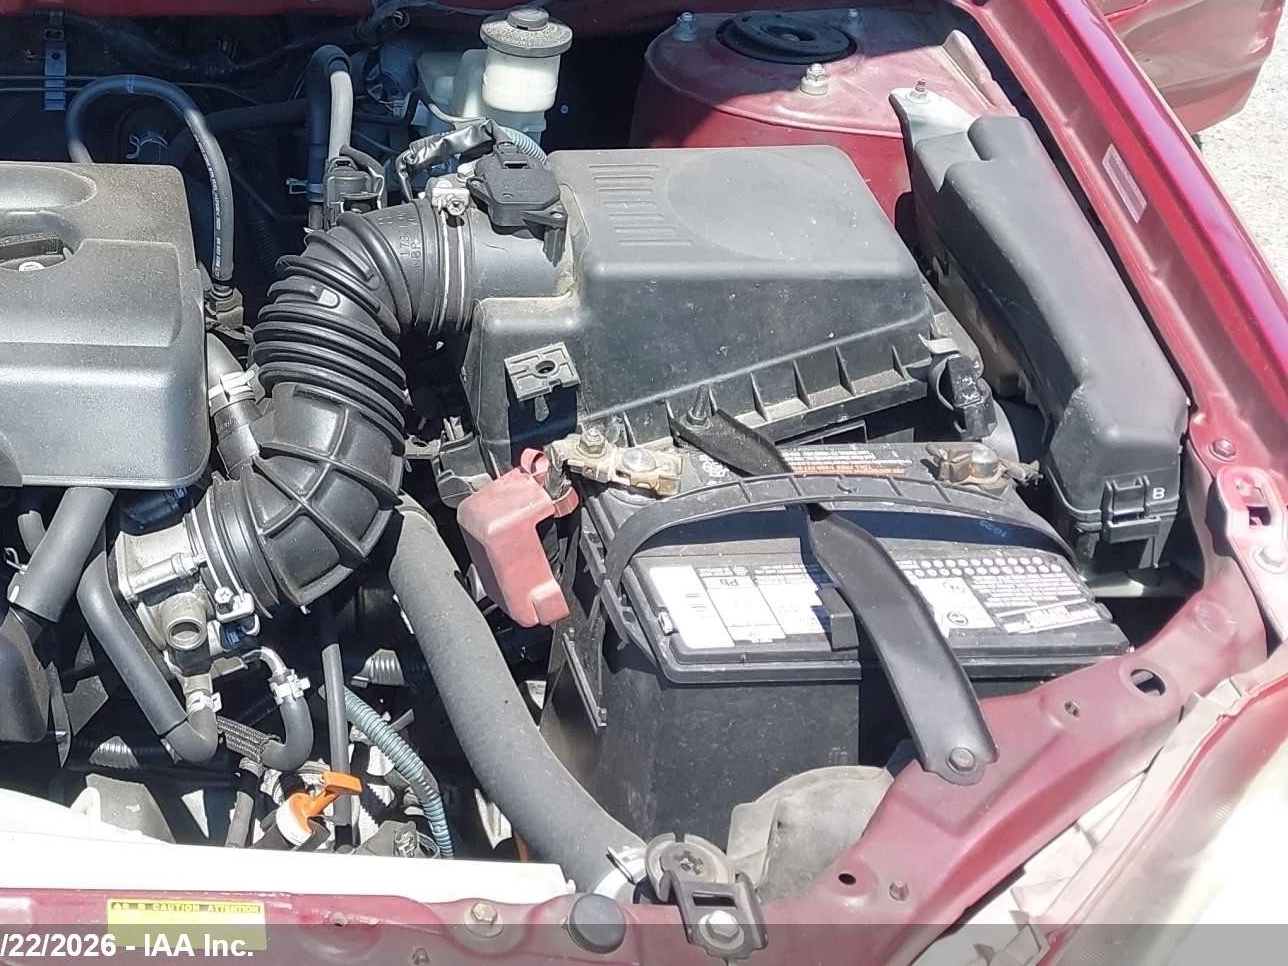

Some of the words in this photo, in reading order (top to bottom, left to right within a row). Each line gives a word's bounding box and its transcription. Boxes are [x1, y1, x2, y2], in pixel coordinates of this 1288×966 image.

[1152, 486, 1166, 500] B
[153, 903, 200, 912] CAUTION
[208, 904, 261, 914] ATTENTION
